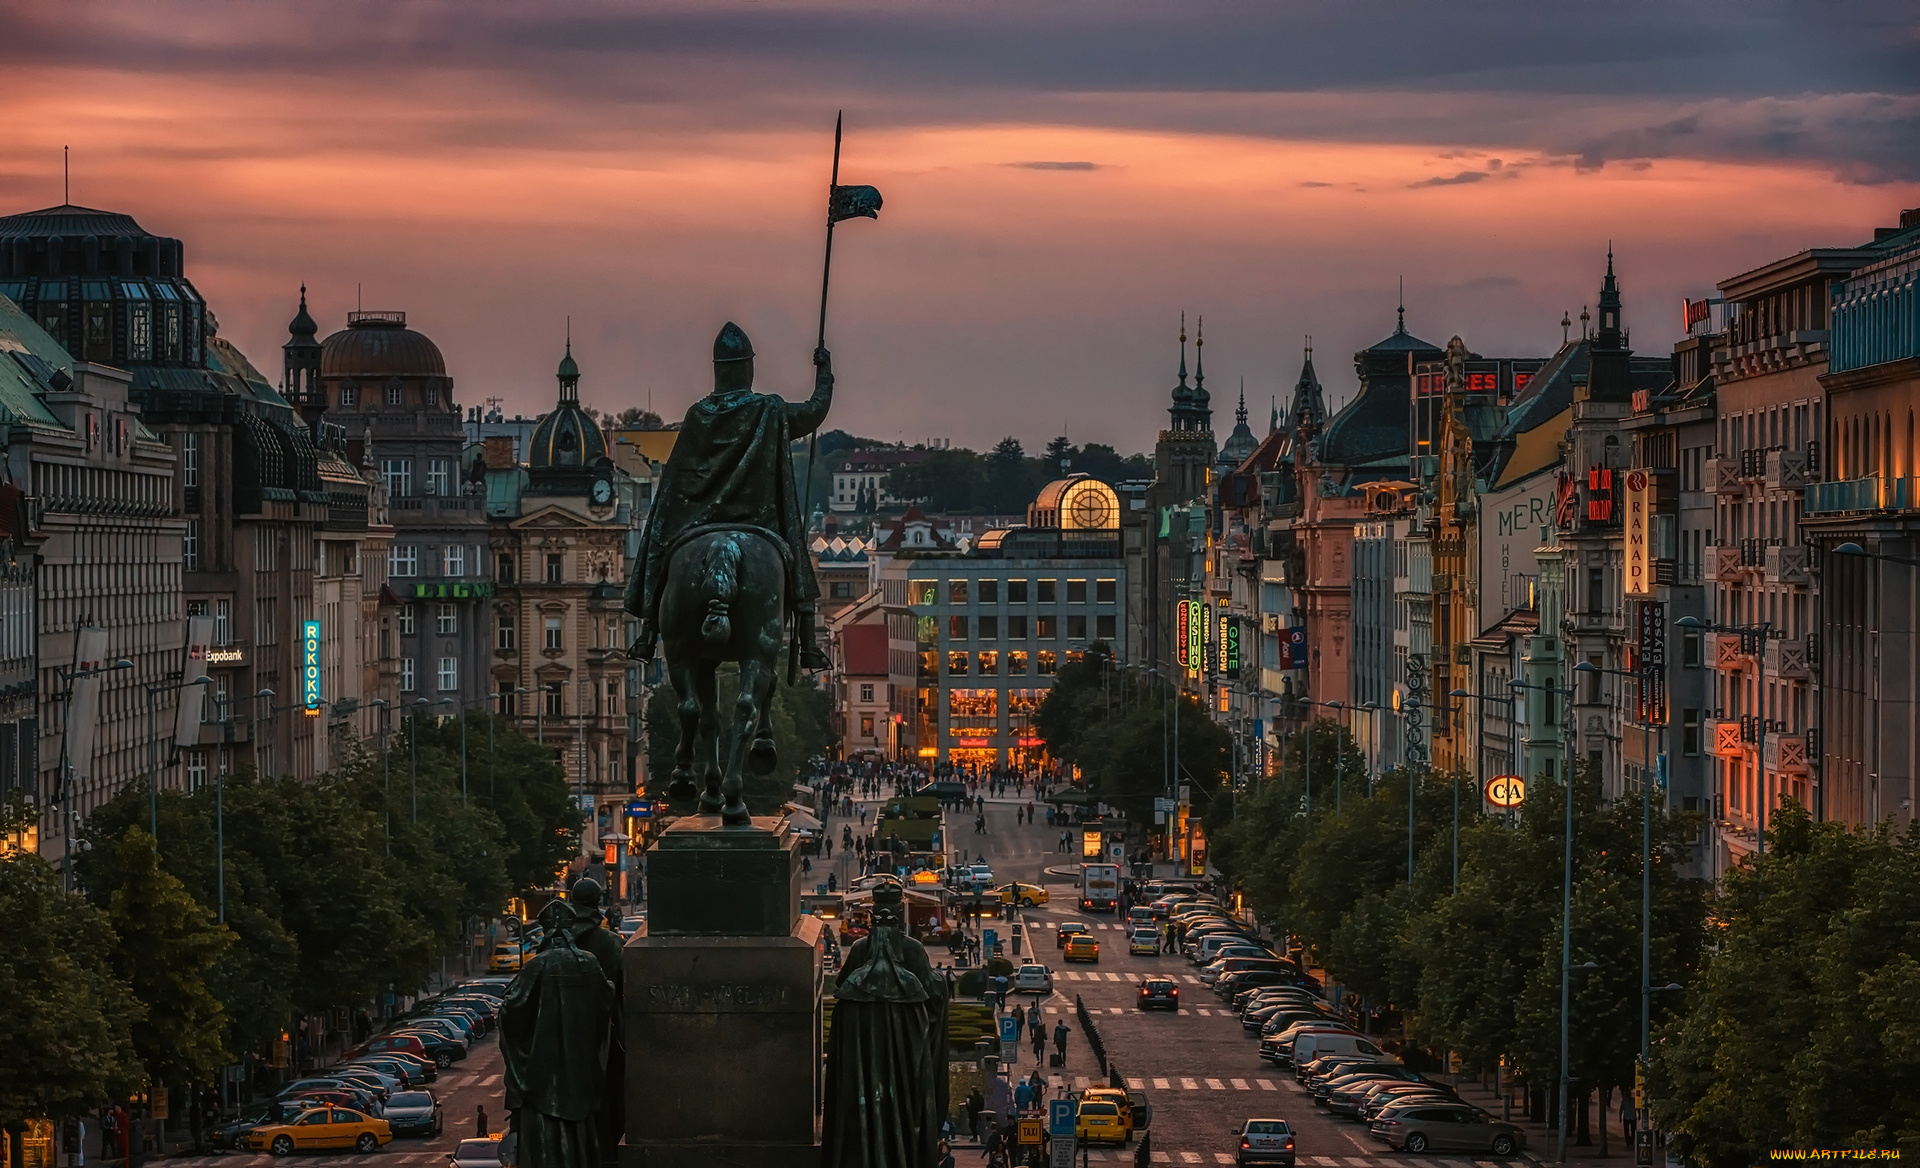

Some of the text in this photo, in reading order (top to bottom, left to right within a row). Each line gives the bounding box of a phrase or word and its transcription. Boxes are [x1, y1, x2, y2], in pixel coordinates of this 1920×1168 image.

[1629, 501, 1643, 593] RAMADA
[1501, 543, 1510, 605] HOTEL
[1219, 617, 1228, 672] McDonald's
[1653, 607, 1664, 664] Elysee
[205, 649, 242, 664] Expobank
[1228, 626, 1239, 669] GATE
[1281, 641, 1290, 658] AON
[1493, 783, 1522, 798] C&A
[1003, 1020, 1013, 1034] P
[1055, 1104, 1071, 1125] P
[1022, 1127, 1038, 1137] TAXI
